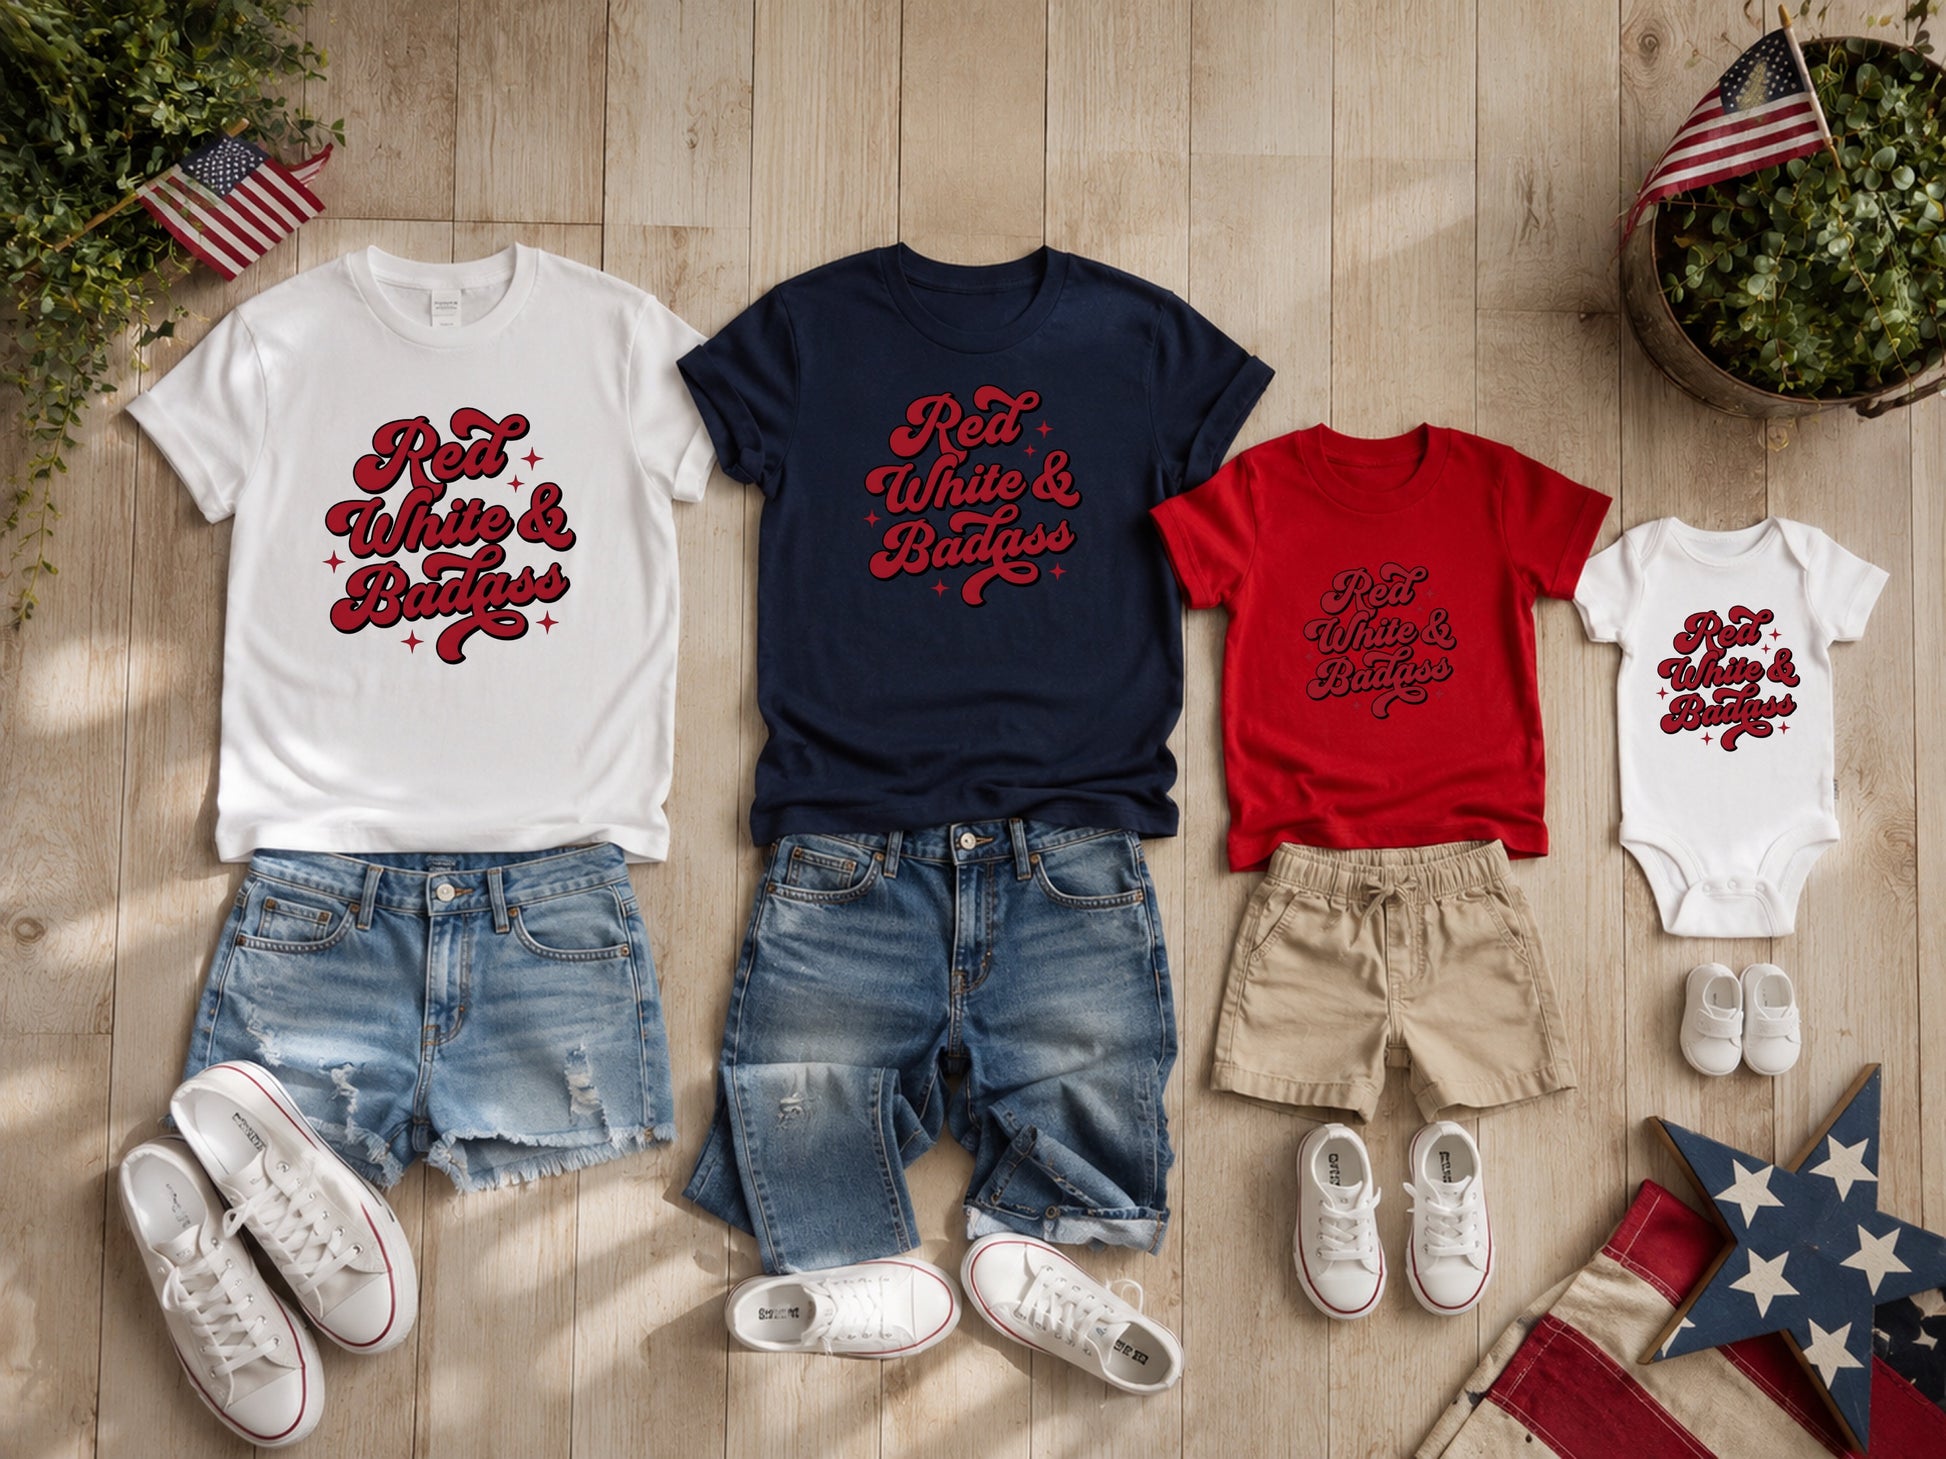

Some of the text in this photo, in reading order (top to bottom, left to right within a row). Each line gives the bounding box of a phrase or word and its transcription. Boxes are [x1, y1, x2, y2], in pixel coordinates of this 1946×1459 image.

[353, 407, 530, 502] Red
[889, 384, 1042, 465] Red
[864, 450, 1082, 516] White &
[325, 482, 576, 559] White &
[868, 503, 1077, 607] Badass
[330, 543, 570, 664] Badass
[1320, 562, 1429, 620] Red
[1303, 607, 1457, 655] White &
[1673, 605, 1774, 659] Red
[1306, 645, 1453, 720] Badass
[1657, 648, 1800, 691] White &
[1660, 683, 1797, 752] Badass
